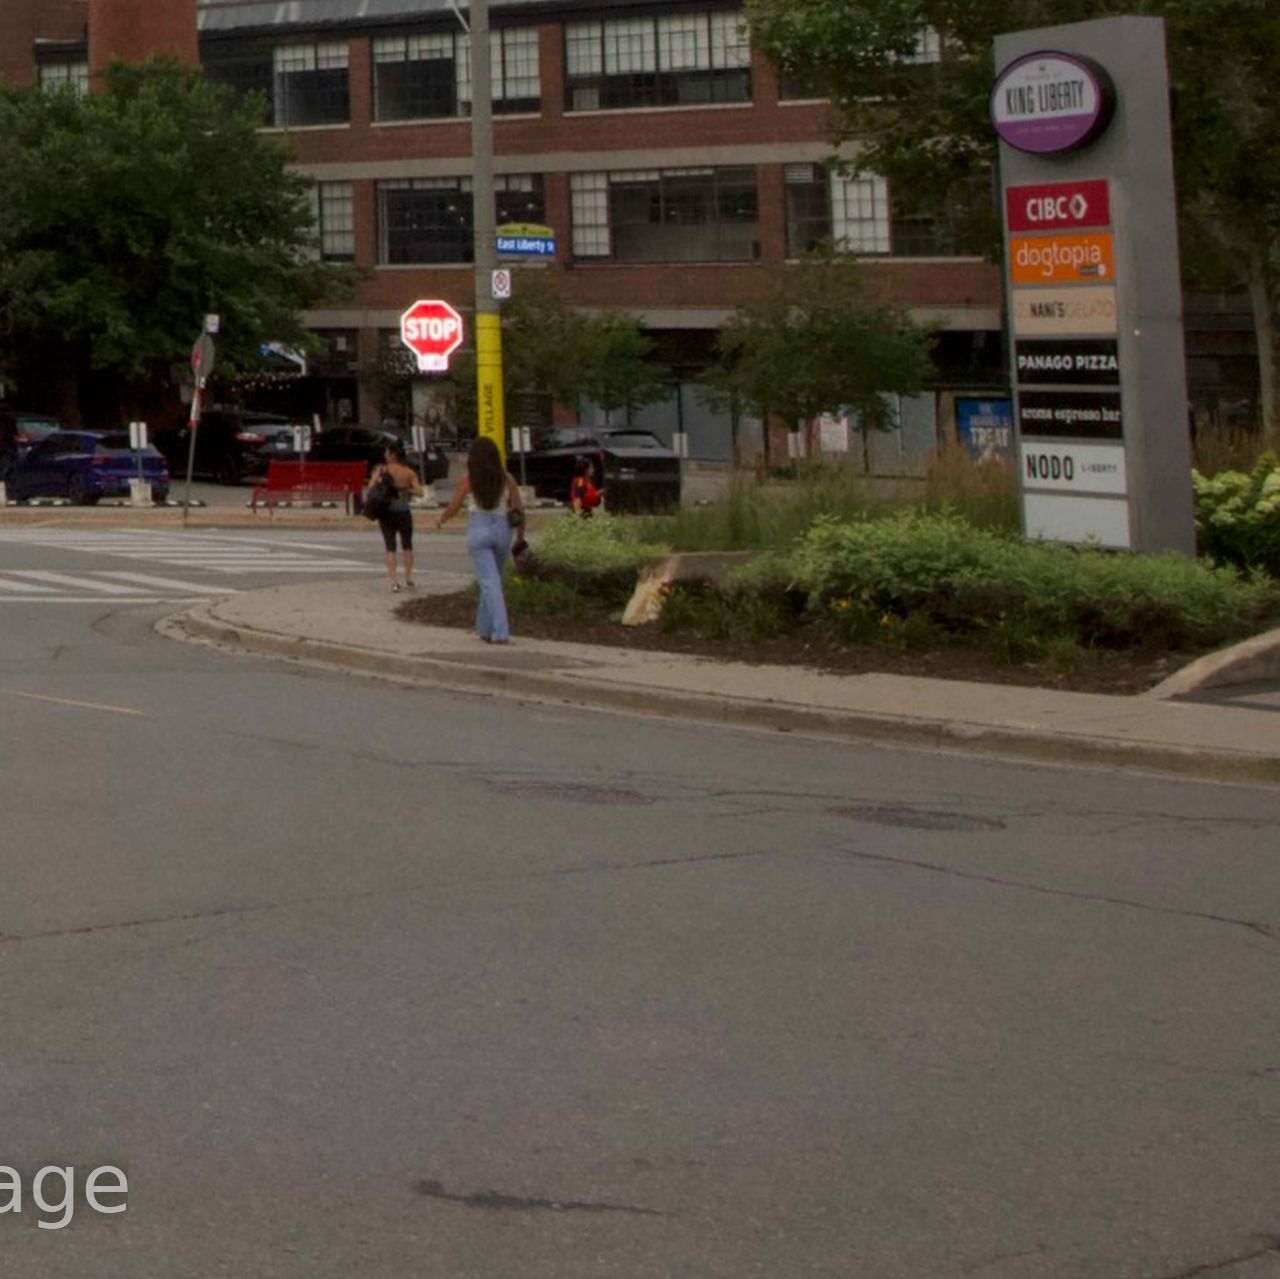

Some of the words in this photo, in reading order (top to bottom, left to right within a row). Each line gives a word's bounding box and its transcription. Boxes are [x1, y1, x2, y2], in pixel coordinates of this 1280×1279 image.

[1006, 85, 1035, 115] KING
[1038, 80, 1085, 112] LIBERTY
[1026, 196, 1068, 221] CIBC
[497, 238, 516, 250] East
[516, 239, 545, 253] Liberty
[1017, 240, 1102, 276] dogtopia
[406, 317, 458, 341] STOP
[1018, 354, 1073, 370] PANAGO
[1075, 354, 1118, 370] PIZZA
[483, 384, 494, 433] VILLAGE
[1055, 408, 1101, 424] espresso
[1026, 454, 1074, 480] NODO
